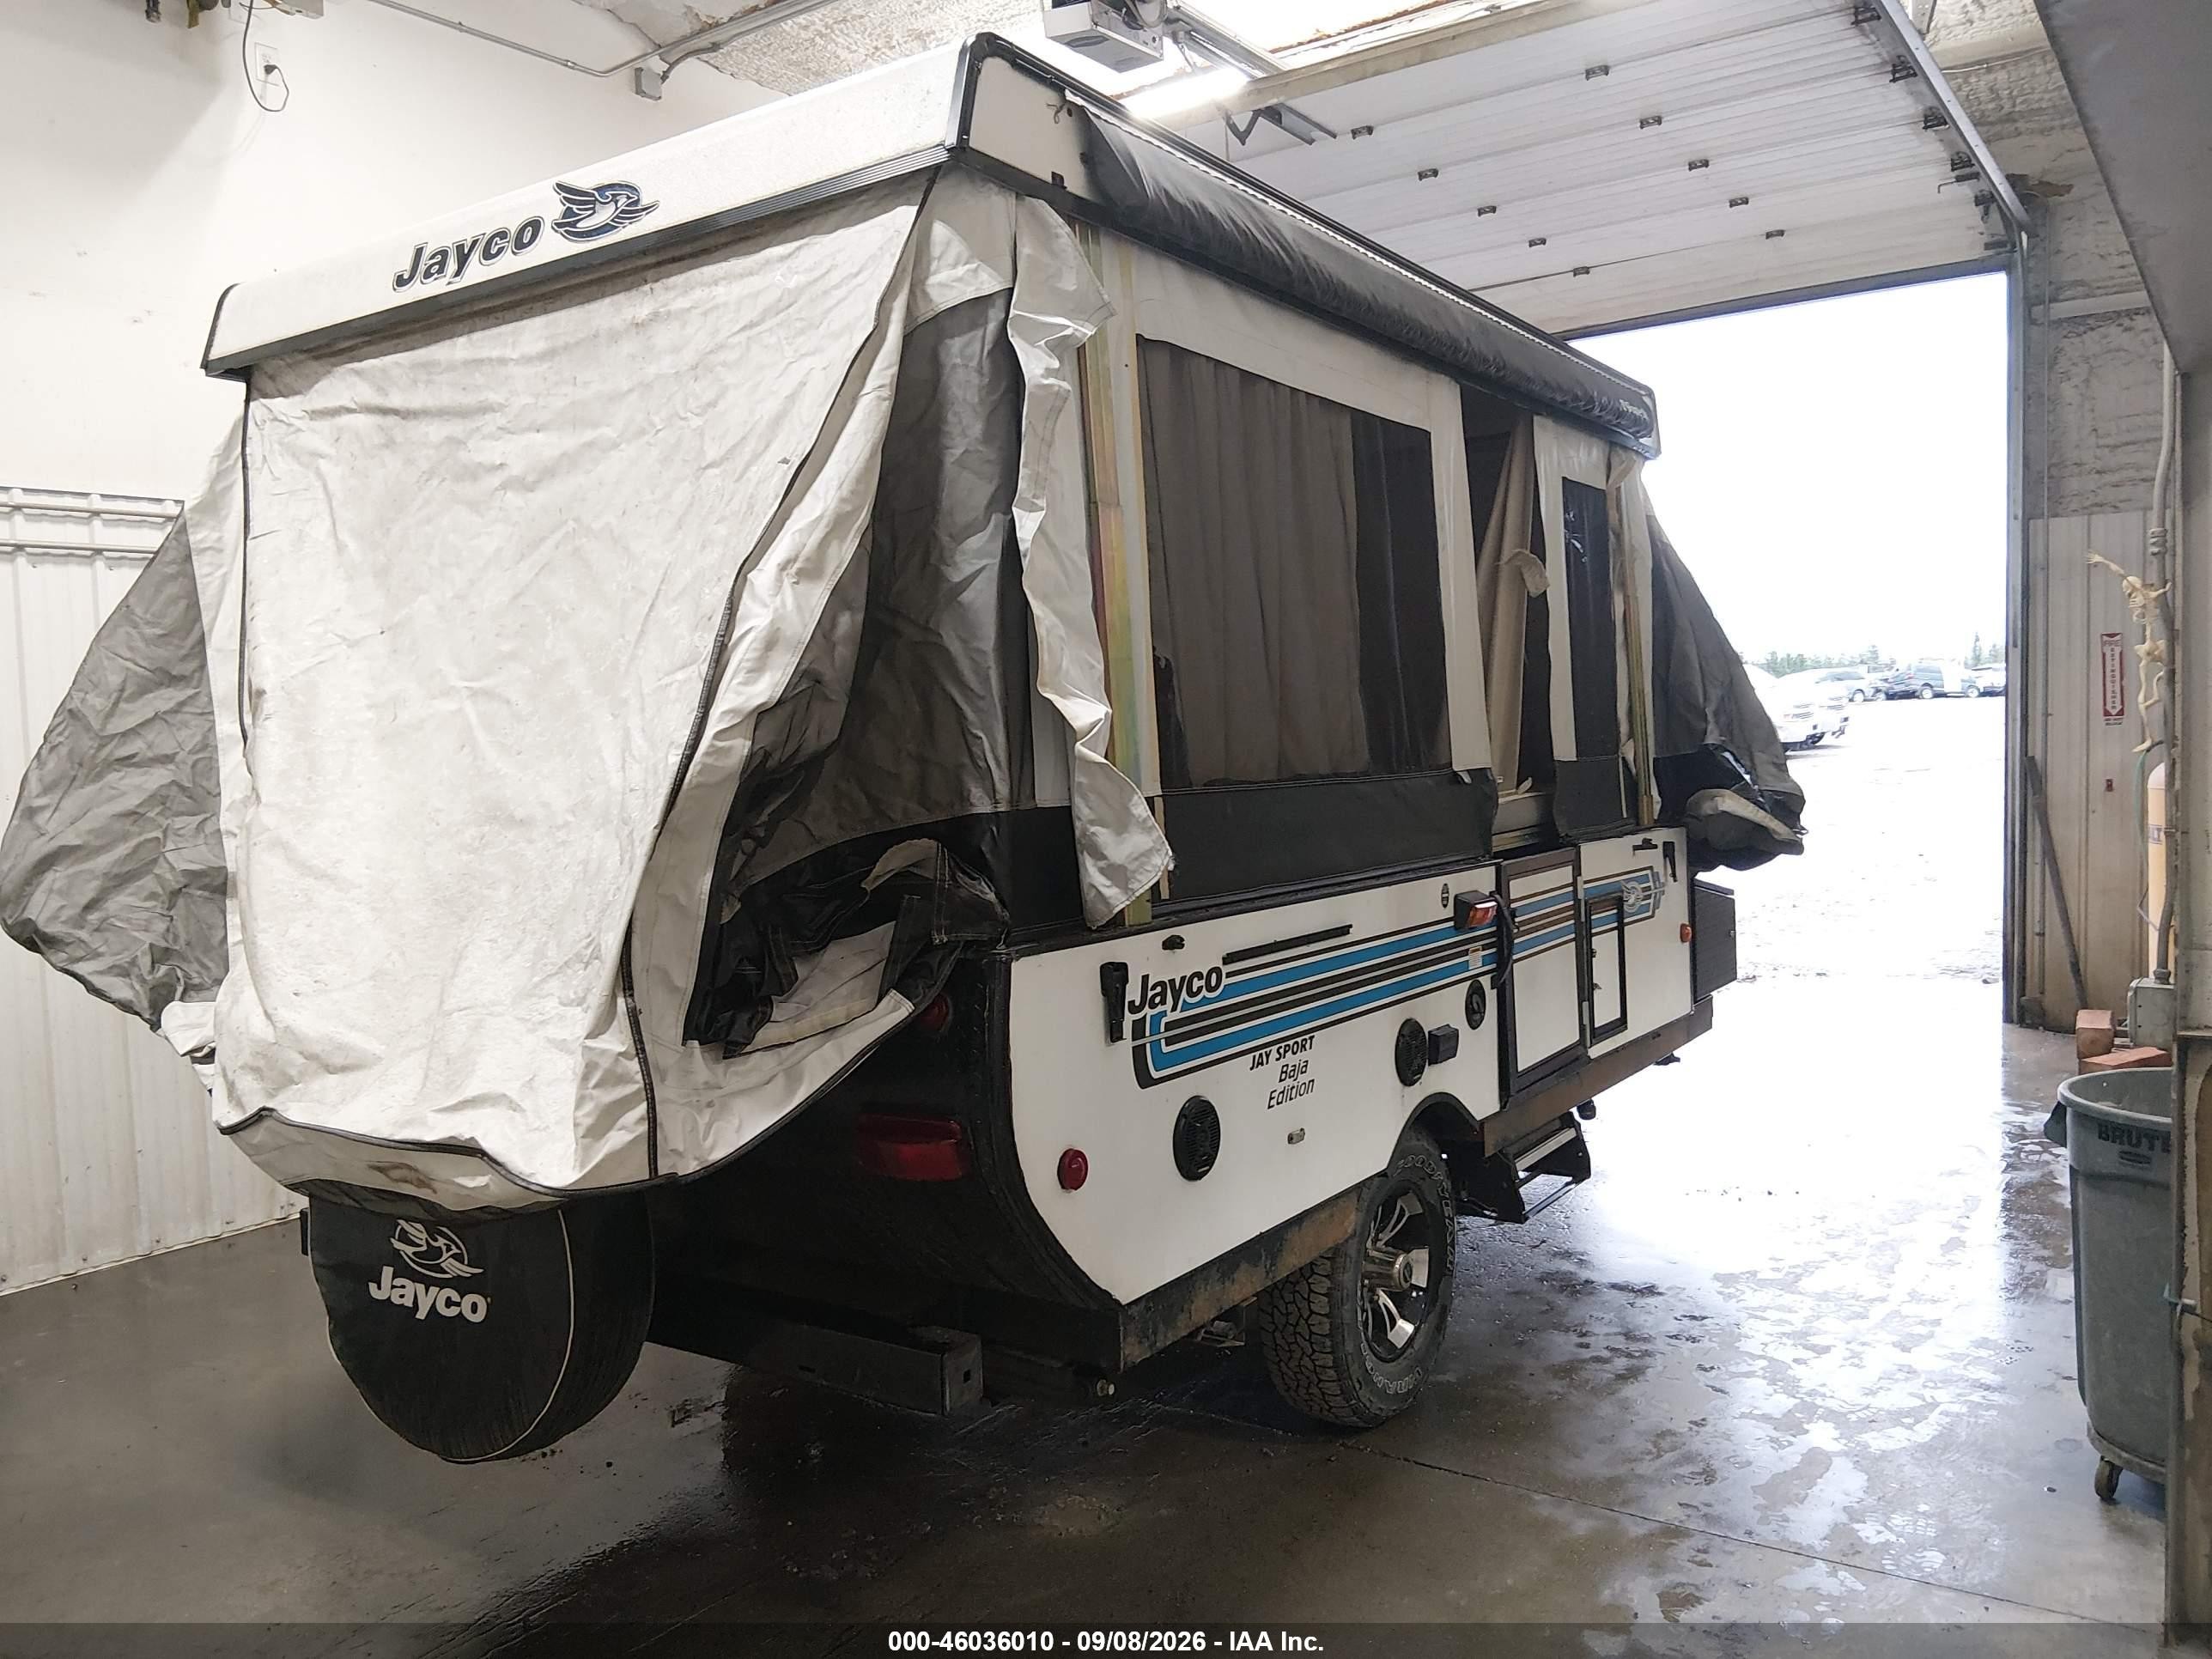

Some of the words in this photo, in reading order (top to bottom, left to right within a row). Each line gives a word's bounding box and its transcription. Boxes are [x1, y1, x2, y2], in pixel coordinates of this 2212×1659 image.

[392, 216, 544, 293] Jayco
[1127, 966, 1223, 1015] Jayco
[1249, 1047, 1272, 1072] JAY
[1275, 1035, 1315, 1063] SPORT
[1278, 1060, 1309, 1084] Baja
[1267, 1078, 1316, 1109] Edition
[368, 1265, 488, 1323] Jayco
